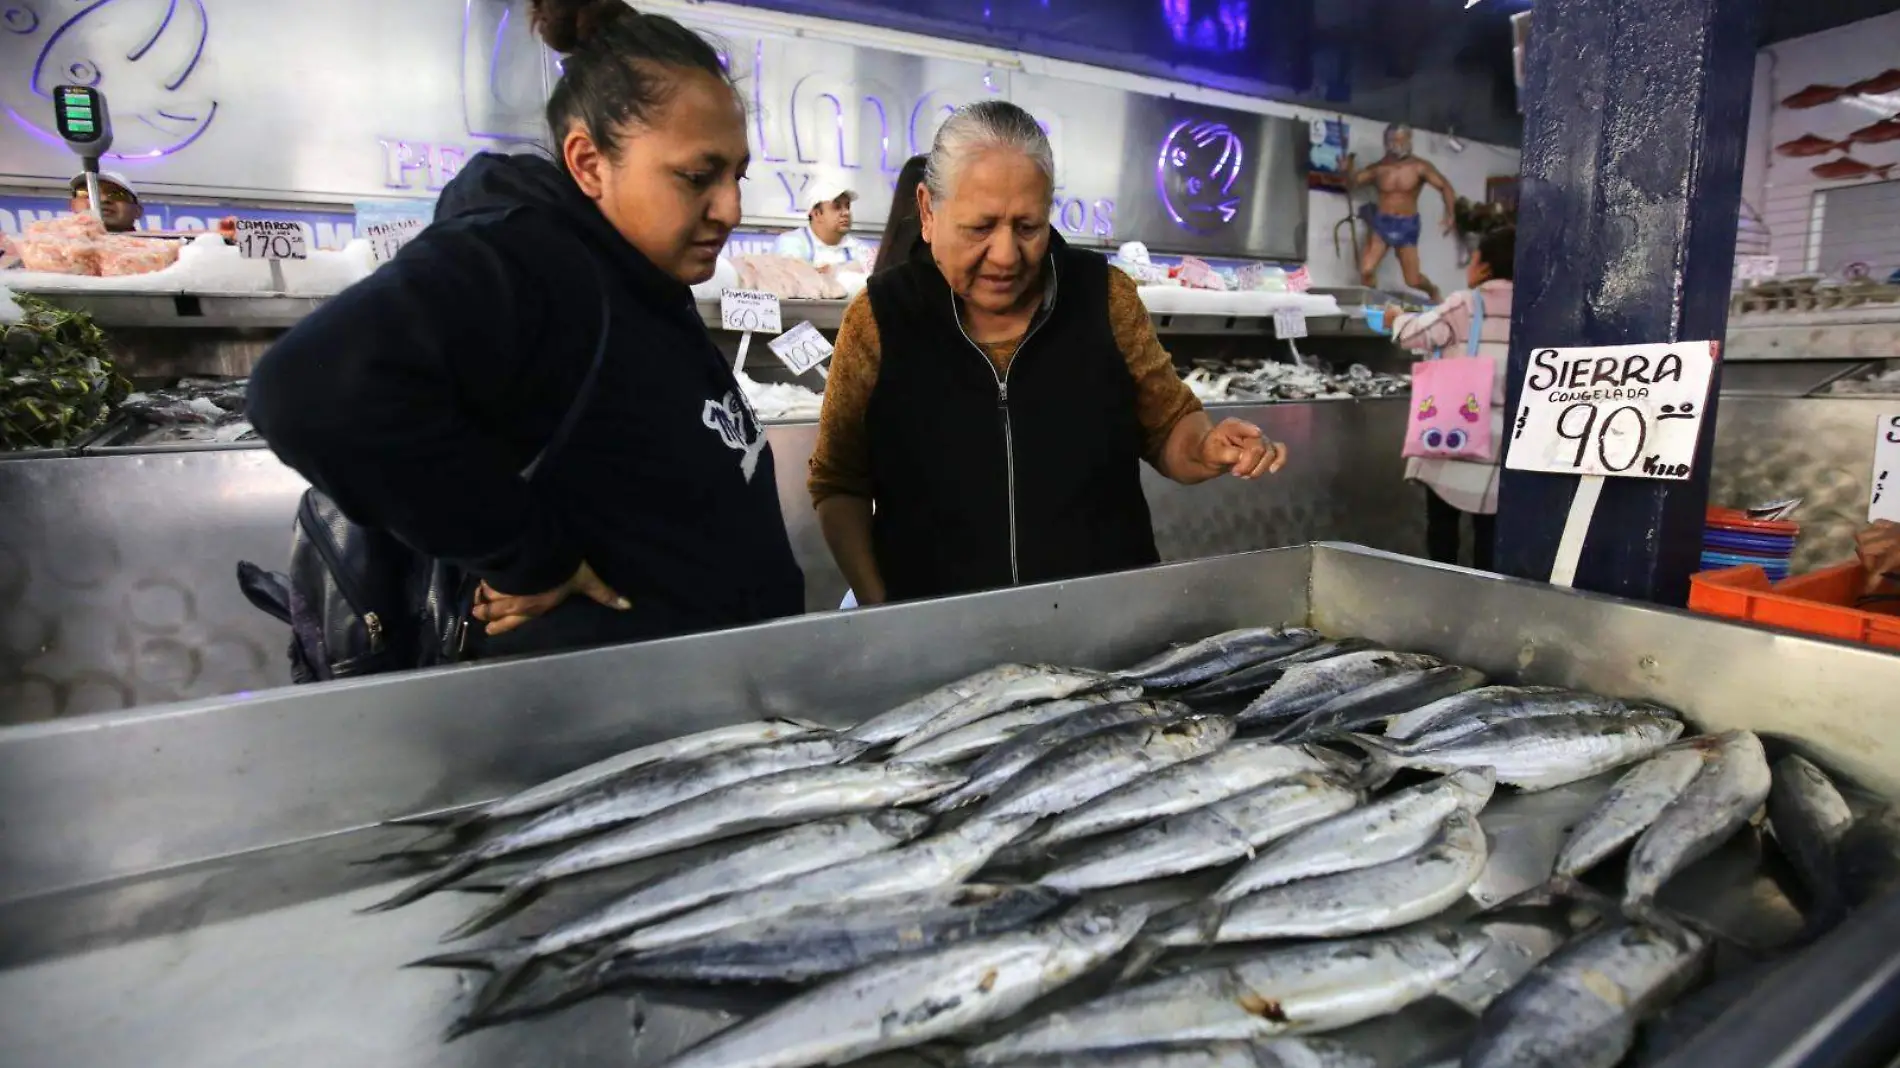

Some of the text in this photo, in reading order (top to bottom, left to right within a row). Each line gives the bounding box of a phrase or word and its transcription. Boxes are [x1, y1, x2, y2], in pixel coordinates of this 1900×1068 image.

[245, 234, 291, 259] 170
[1529, 350, 1683, 391] SIERRA
[1548, 387, 1650, 403] CONGELADA
[1556, 403, 1647, 472] 90
